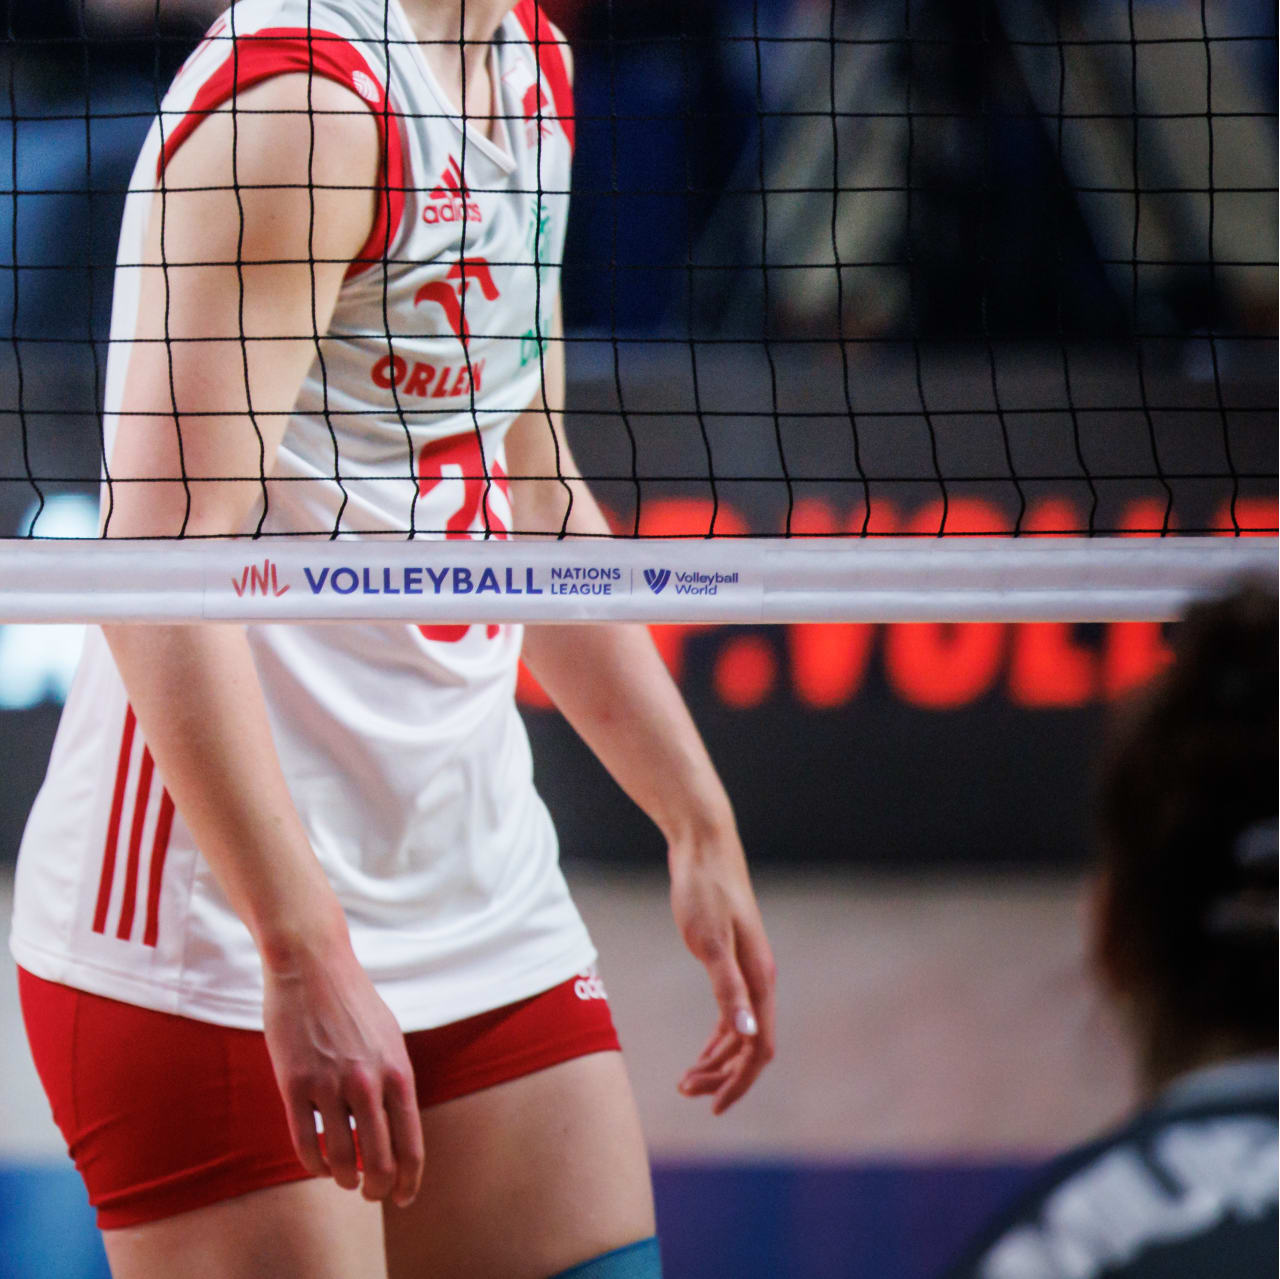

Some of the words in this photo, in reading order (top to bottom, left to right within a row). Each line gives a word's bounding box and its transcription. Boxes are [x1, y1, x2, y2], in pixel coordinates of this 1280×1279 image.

[371, 354, 487, 399] ORLEN
[231, 558, 290, 597] VNL
[303, 567, 543, 595] VOLLEYBALL
[551, 567, 621, 581] NATIONS
[675, 571, 739, 585] Volleyball
[551, 582, 612, 596] LEAGUE
[675, 584, 718, 596] World
